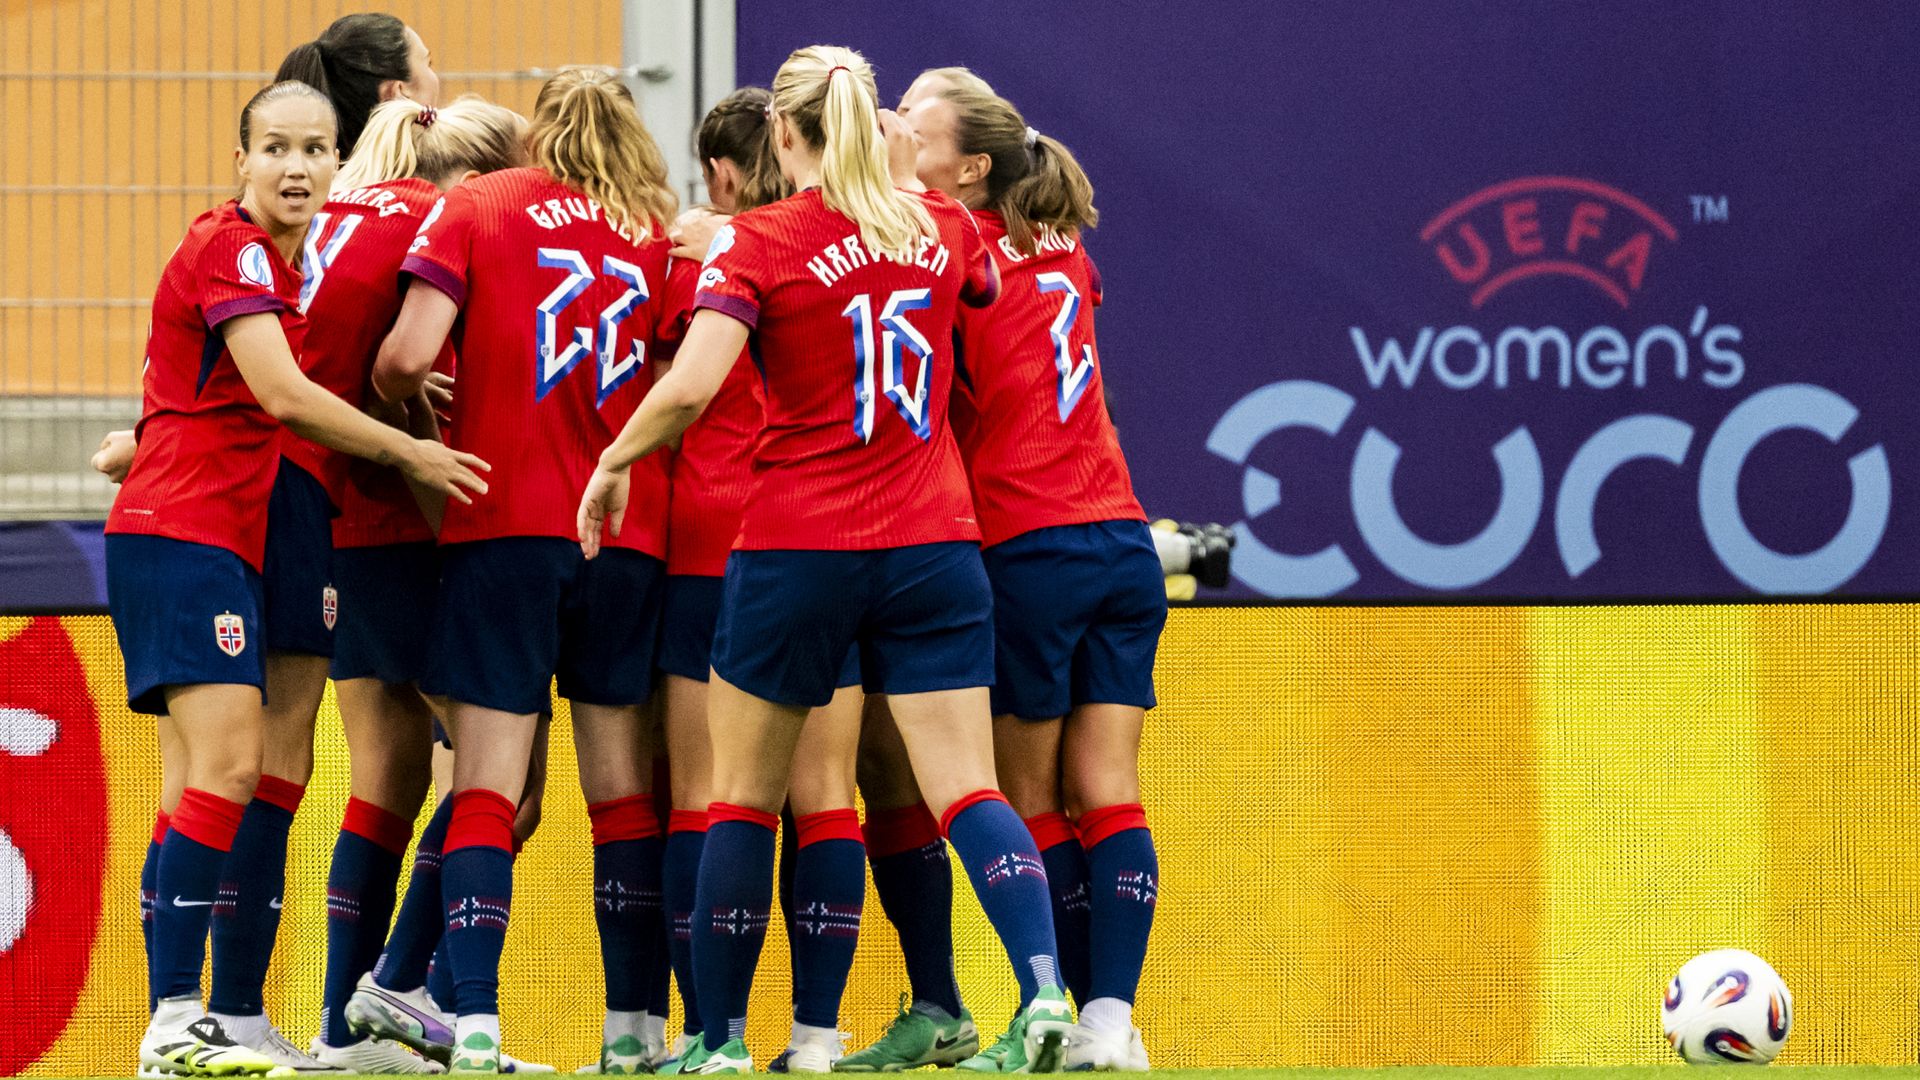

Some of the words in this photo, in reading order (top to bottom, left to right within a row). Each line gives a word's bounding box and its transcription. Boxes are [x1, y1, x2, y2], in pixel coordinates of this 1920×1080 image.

[1436, 201, 1654, 290] UEFA
[1689, 195, 1729, 222] TM
[535, 247, 650, 410] 22
[841, 287, 933, 446] 16
[1036, 271, 1094, 424] 2
[1349, 306, 1746, 390] women's
